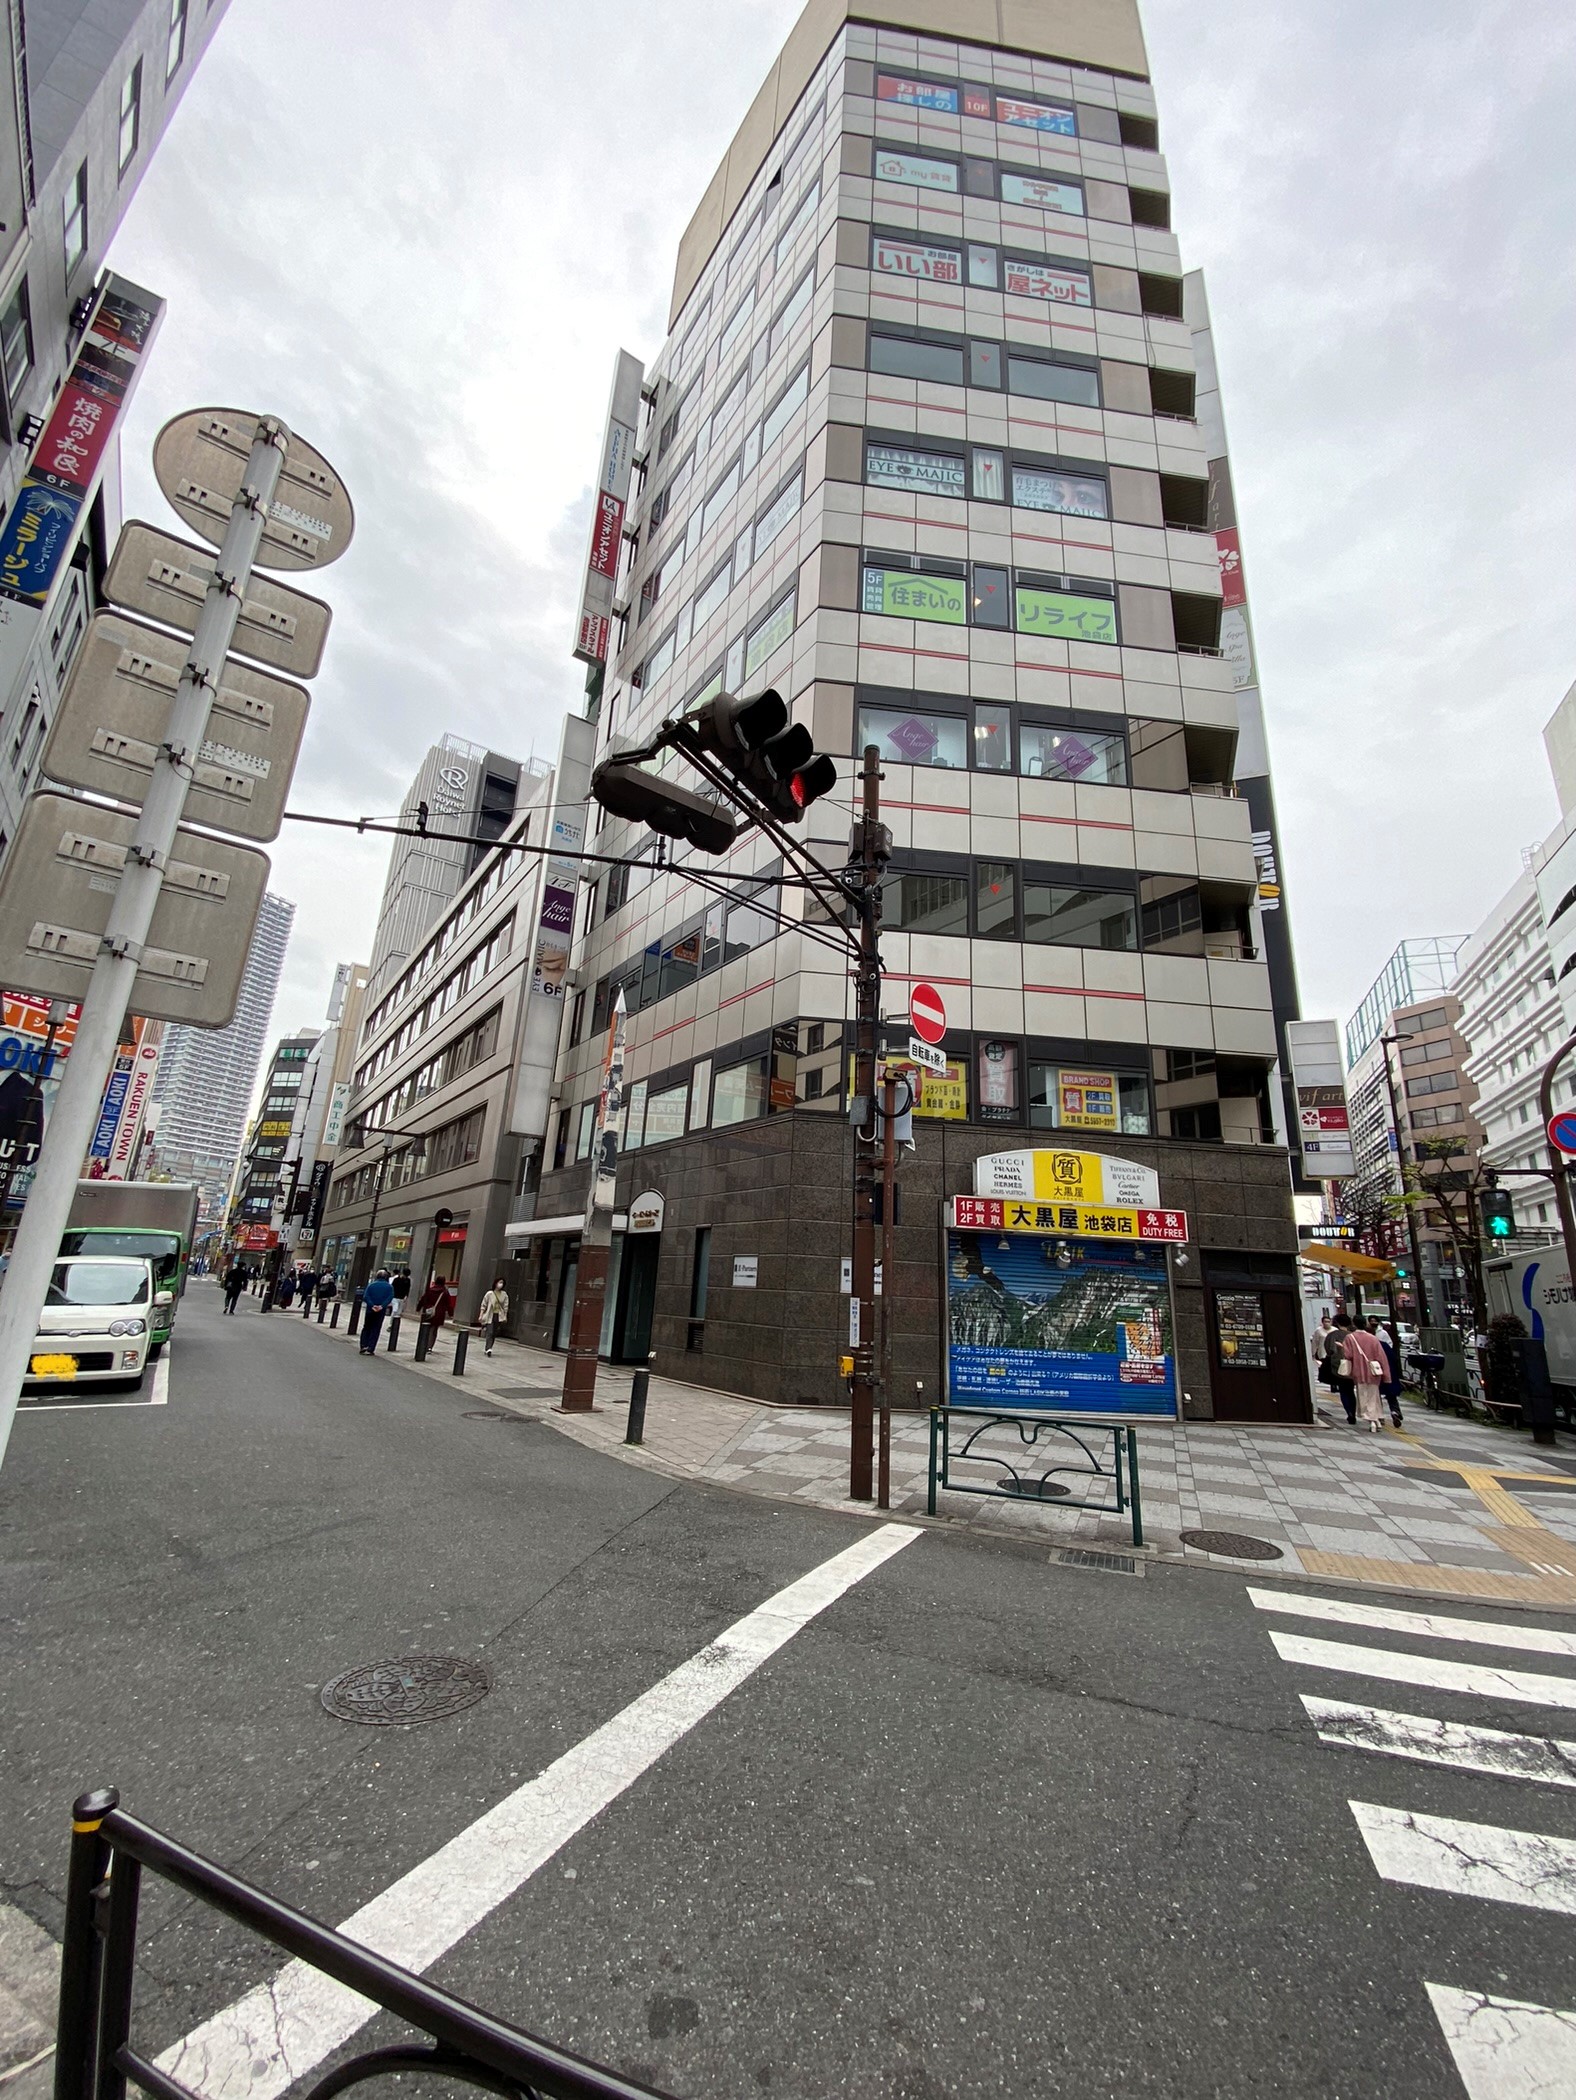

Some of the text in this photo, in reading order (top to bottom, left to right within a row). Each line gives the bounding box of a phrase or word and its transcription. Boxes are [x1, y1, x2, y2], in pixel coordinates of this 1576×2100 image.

[967, 101, 988, 113] 10F
[878, 252, 958, 281] いい部
[1008, 273, 1089, 302] 屋ネット
[53, 397, 103, 476] 焼肉の和民
[868, 459, 963, 483] EYE MAJIC
[46, 474, 71, 488] 6F
[867, 571, 883, 585] 5F
[891, 587, 961, 611] 住まいの
[1020, 604, 1111, 632] リライフ
[437, 785, 465, 801] Daiwa
[433, 793, 465, 810] Roynet
[542, 907, 570, 923] hair
[543, 981, 563, 997] 6F
[0, 1037, 58, 1076] OKI
[911, 1043, 945, 1069] 自転車を除く
[1063, 1075, 1110, 1087] BRAND SHOP
[108, 1077, 128, 1106] AOKI
[1322, 1092, 1344, 1101] art
[1066, 1091, 1081, 1110] 質
[116, 1072, 148, 1161] RAKUEN TOWN
[326, 1100, 344, 1142] 商工中金
[95, 1119, 116, 1148] AOKI
[1306, 1143, 1319, 1151] 4F
[990, 1157, 1025, 1167] GUCCI
[994, 1166, 1021, 1174] PRADA
[1057, 1158, 1077, 1180] 質
[993, 1173, 1023, 1181] CHANEL
[1112, 1174, 1146, 1182] BVLGARI
[1117, 1180, 1140, 1189] Cartier
[305, 1172, 325, 1227] ダイワネットホテル
[1053, 1186, 1084, 1198] 大黒屋
[1118, 1189, 1141, 1197] OMEGA
[960, 1200, 1000, 1213] 1F 販売
[1116, 1196, 1144, 1205] ROLEX
[960, 1212, 1001, 1226] 2F 買取
[1011, 1204, 1133, 1234] 大黒屋 池袋店
[1146, 1212, 1179, 1228] 免税
[1142, 1226, 1184, 1239] DUTY FREE
[1312, 1226, 1355, 1238] DOUTOR
